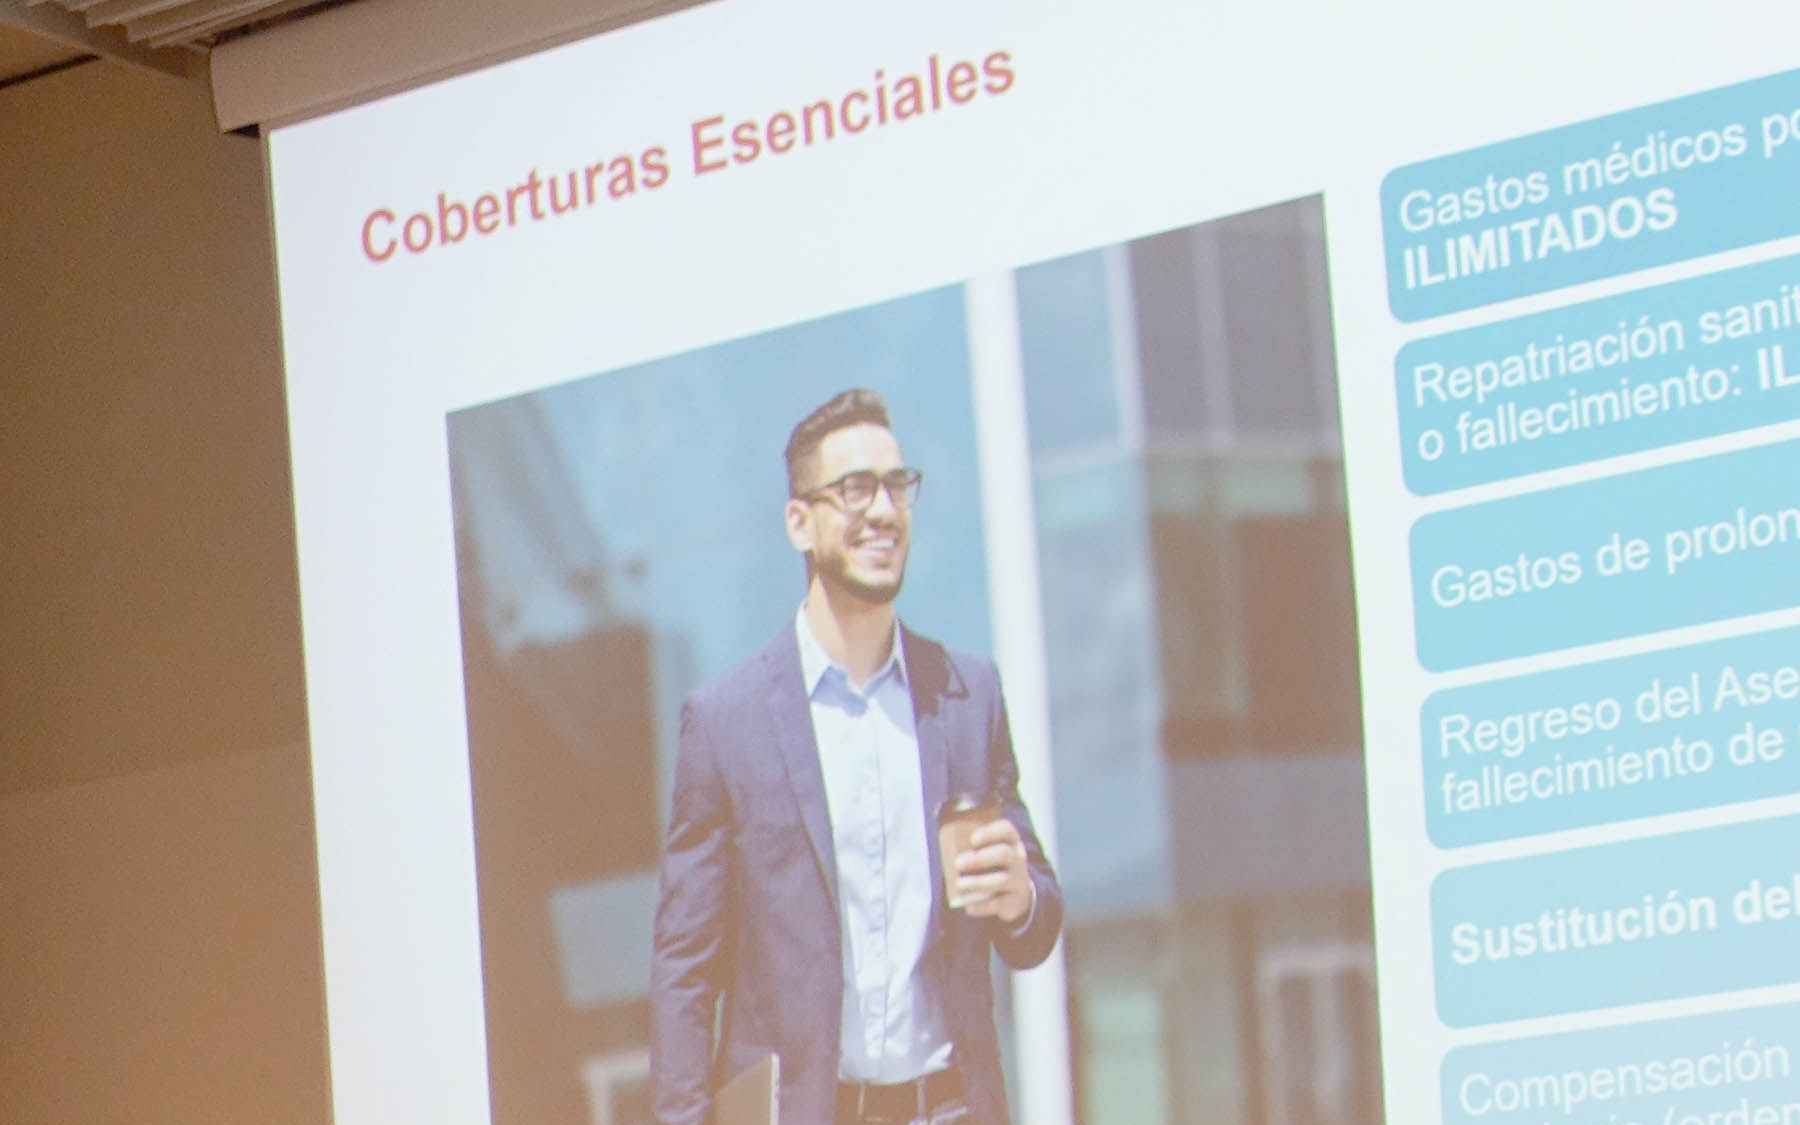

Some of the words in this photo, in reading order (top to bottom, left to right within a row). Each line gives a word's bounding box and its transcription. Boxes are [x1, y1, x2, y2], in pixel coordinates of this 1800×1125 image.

[360, 140, 671, 263] Coberturas
[691, 48, 1016, 174] Esenciales
[1400, 171, 1550, 233] Gastos
[1563, 123, 1747, 196] médicos
[1403, 188, 1678, 289] ILIMITADOS
[1413, 316, 1684, 408] Repatriación
[1417, 429, 1444, 462] o
[1455, 362, 1743, 455] fallecimiento:
[1430, 550, 1583, 608] Gastos
[1596, 533, 1651, 576] de
[1439, 697, 1621, 758] Regreso
[1635, 672, 1701, 725] del
[1440, 735, 1714, 814] fallecimiento
[1729, 723, 1785, 768] de
[1450, 890, 1718, 966] Sustitución
[1458, 1039, 1790, 1117] Compensación
